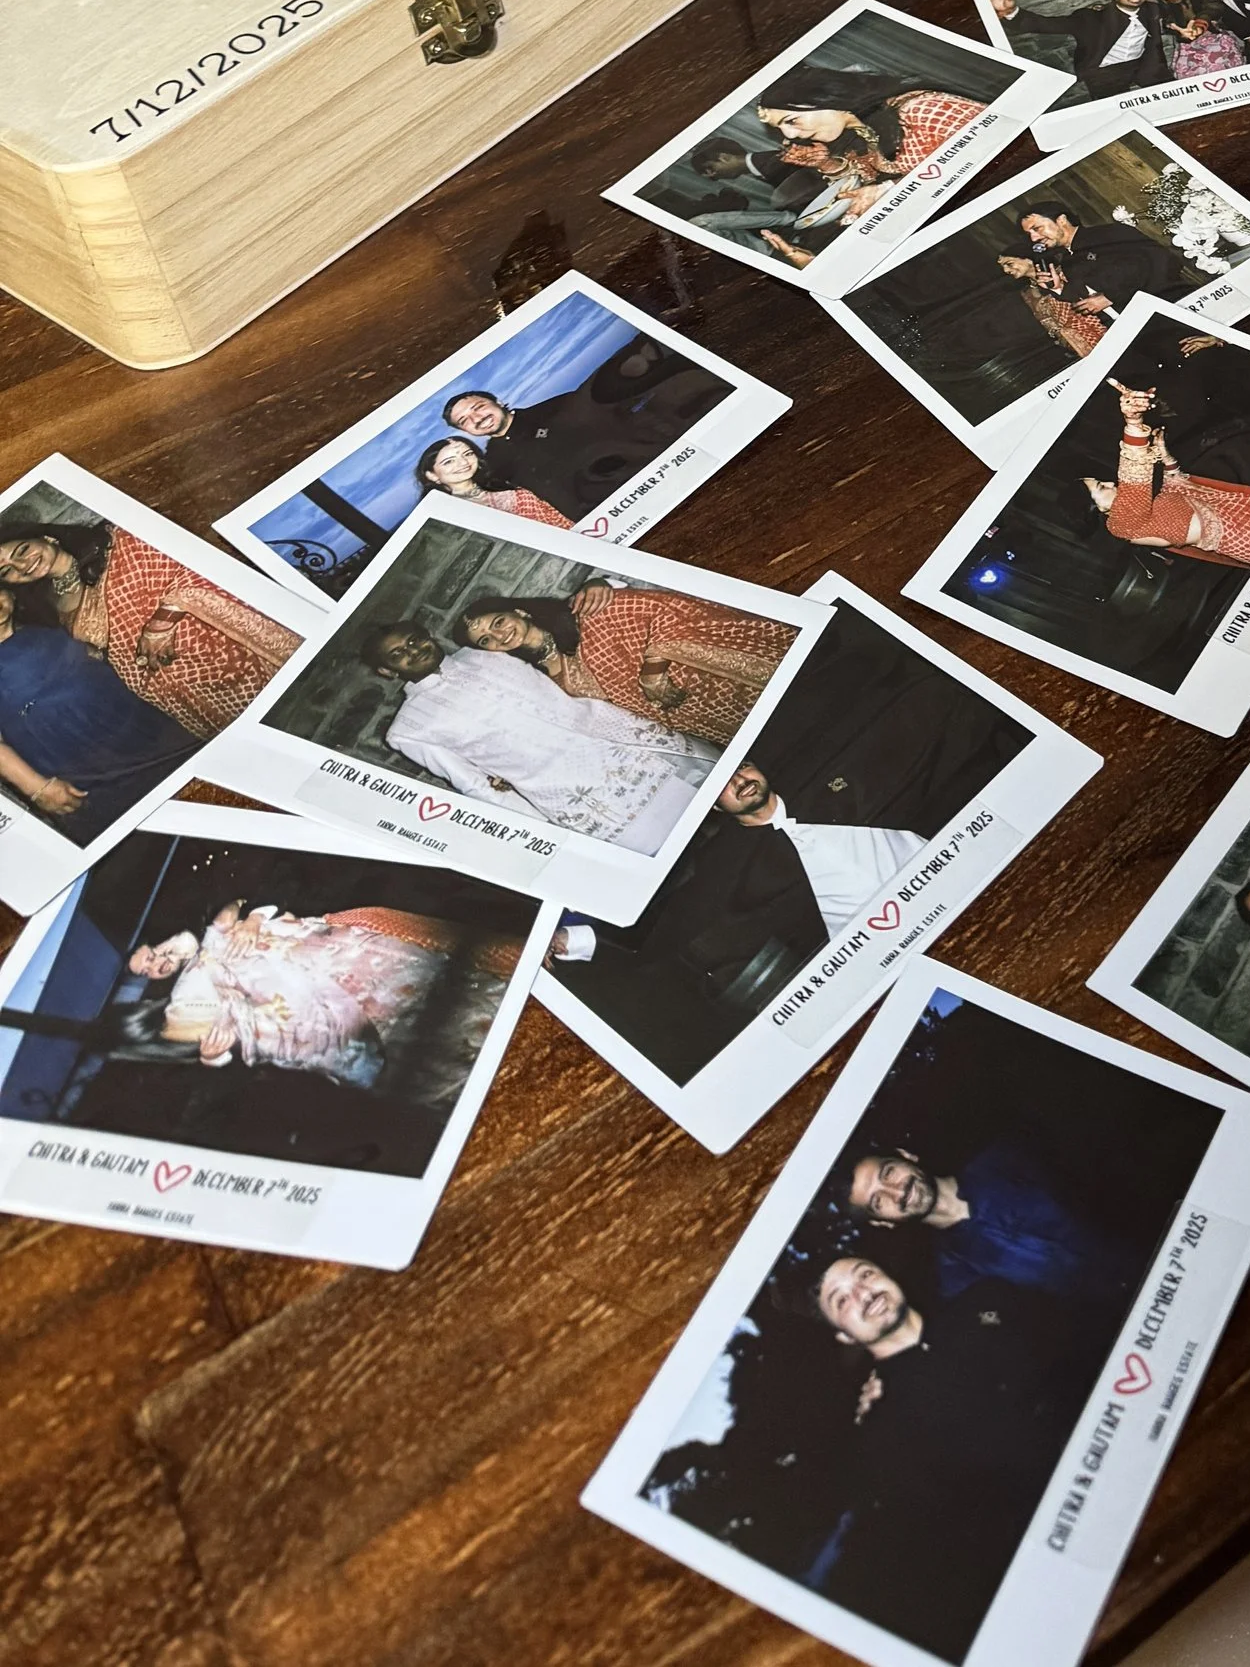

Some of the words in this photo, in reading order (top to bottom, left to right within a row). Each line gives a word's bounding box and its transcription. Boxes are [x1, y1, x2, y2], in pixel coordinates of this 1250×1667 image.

[1119, 95, 1152, 110] CHITRA
[1161, 84, 1200, 100] GAUTAM
[858, 212, 888, 236] CHITRA
[889, 180, 922, 208] GAUTAM
[936, 134, 974, 165] DECEMBER
[978, 114, 999, 128] 2025
[1210, 284, 1233, 301] 2025
[608, 477, 660, 518] DECEMBER
[670, 446, 696, 467] 2025
[319, 758, 361, 783] CHITRA
[368, 778, 418, 805] GAUTAM
[449, 808, 510, 840] DECEMBER
[524, 836, 557, 856] 2025
[772, 985, 816, 1026] CHITRA
[821, 930, 871, 978] GAUTAM
[897, 849, 956, 903] DECEMBER
[965, 810, 994, 838] 2025
[27, 1140, 78, 1164] CHITRA
[90, 1150, 150, 1177] GAUTAM
[192, 1169, 265, 1196] DECEMBER
[284, 1184, 322, 1206] 2025
